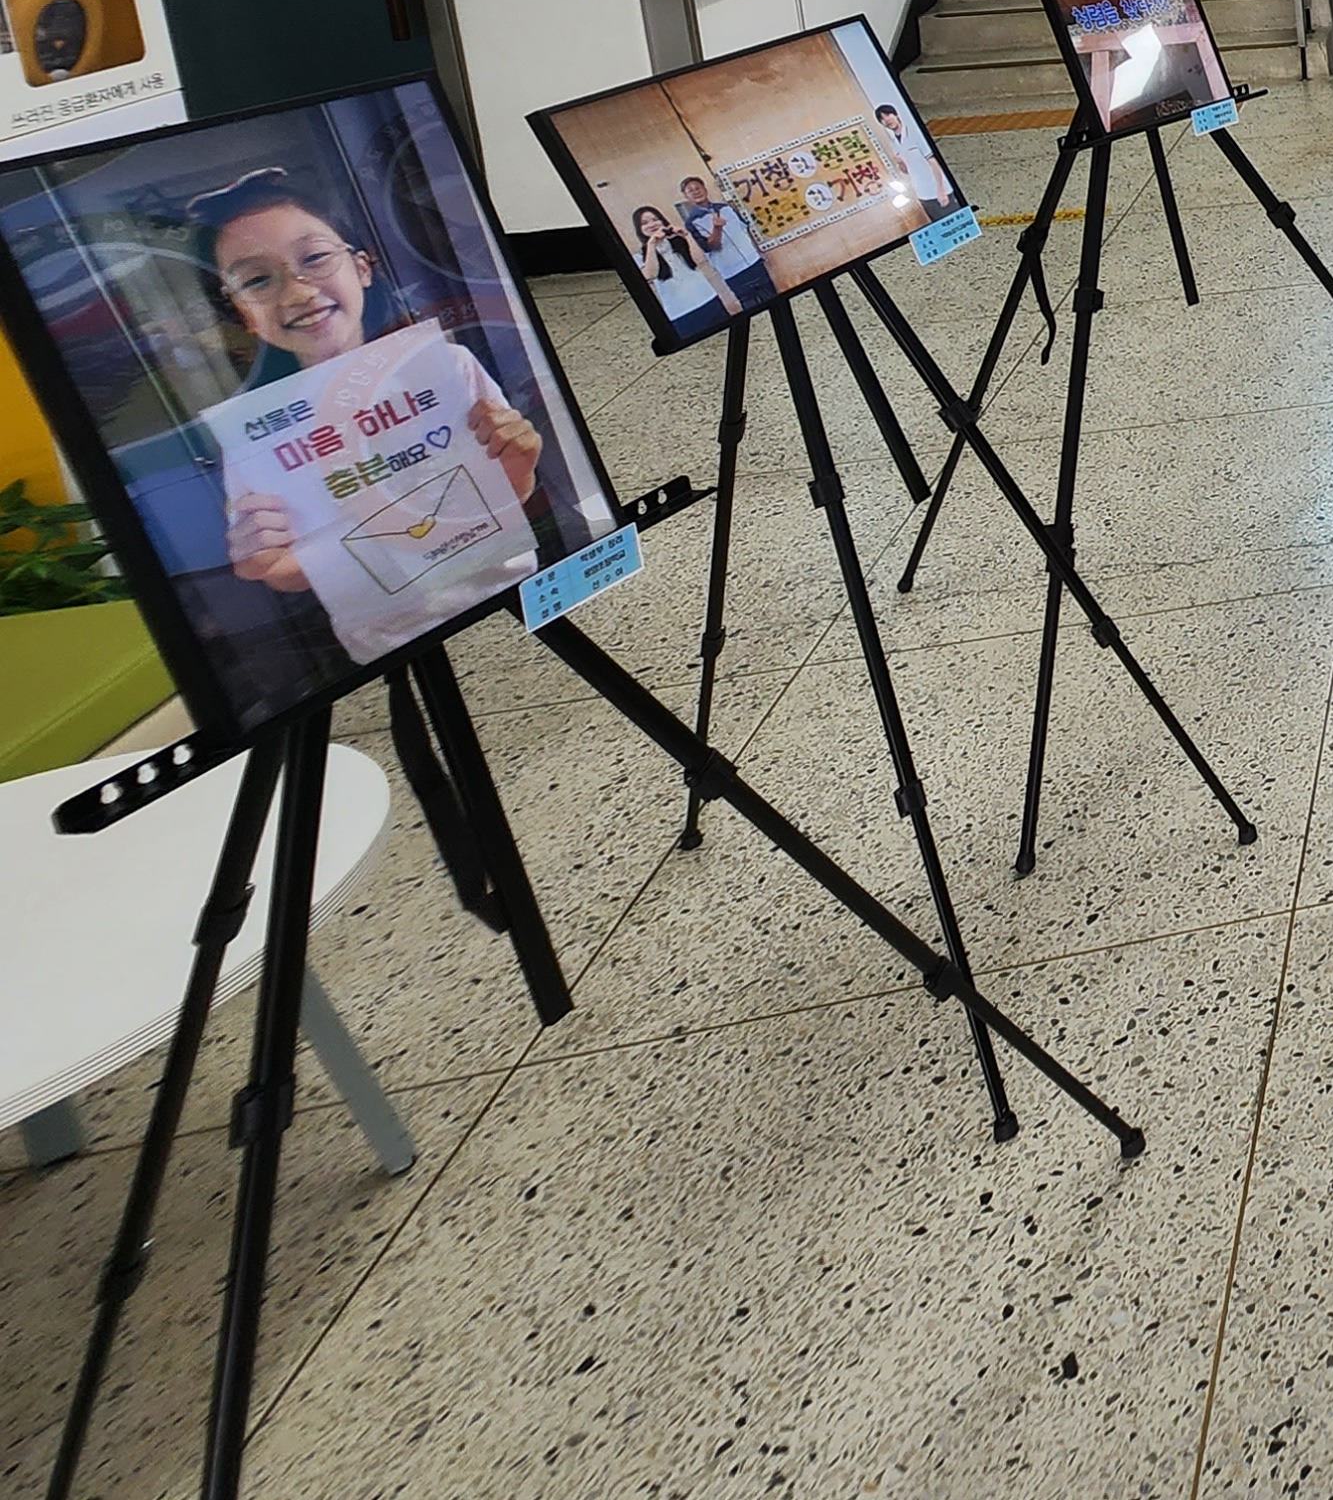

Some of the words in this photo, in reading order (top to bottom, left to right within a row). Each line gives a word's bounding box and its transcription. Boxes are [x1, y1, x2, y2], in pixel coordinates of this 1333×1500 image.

[1072, 0, 1121, 31] 청렴을
[11, 105, 56, 129] 쓰러진
[58, 80, 137, 116] 응급환자에게
[140, 72, 165, 91] 사용
[827, 161, 884, 202] 거창
[245, 399, 316, 441] 선물은
[273, 424, 345, 472] 마음
[353, 388, 440, 437] 하나로
[324, 442, 432, 499] 충분해요
